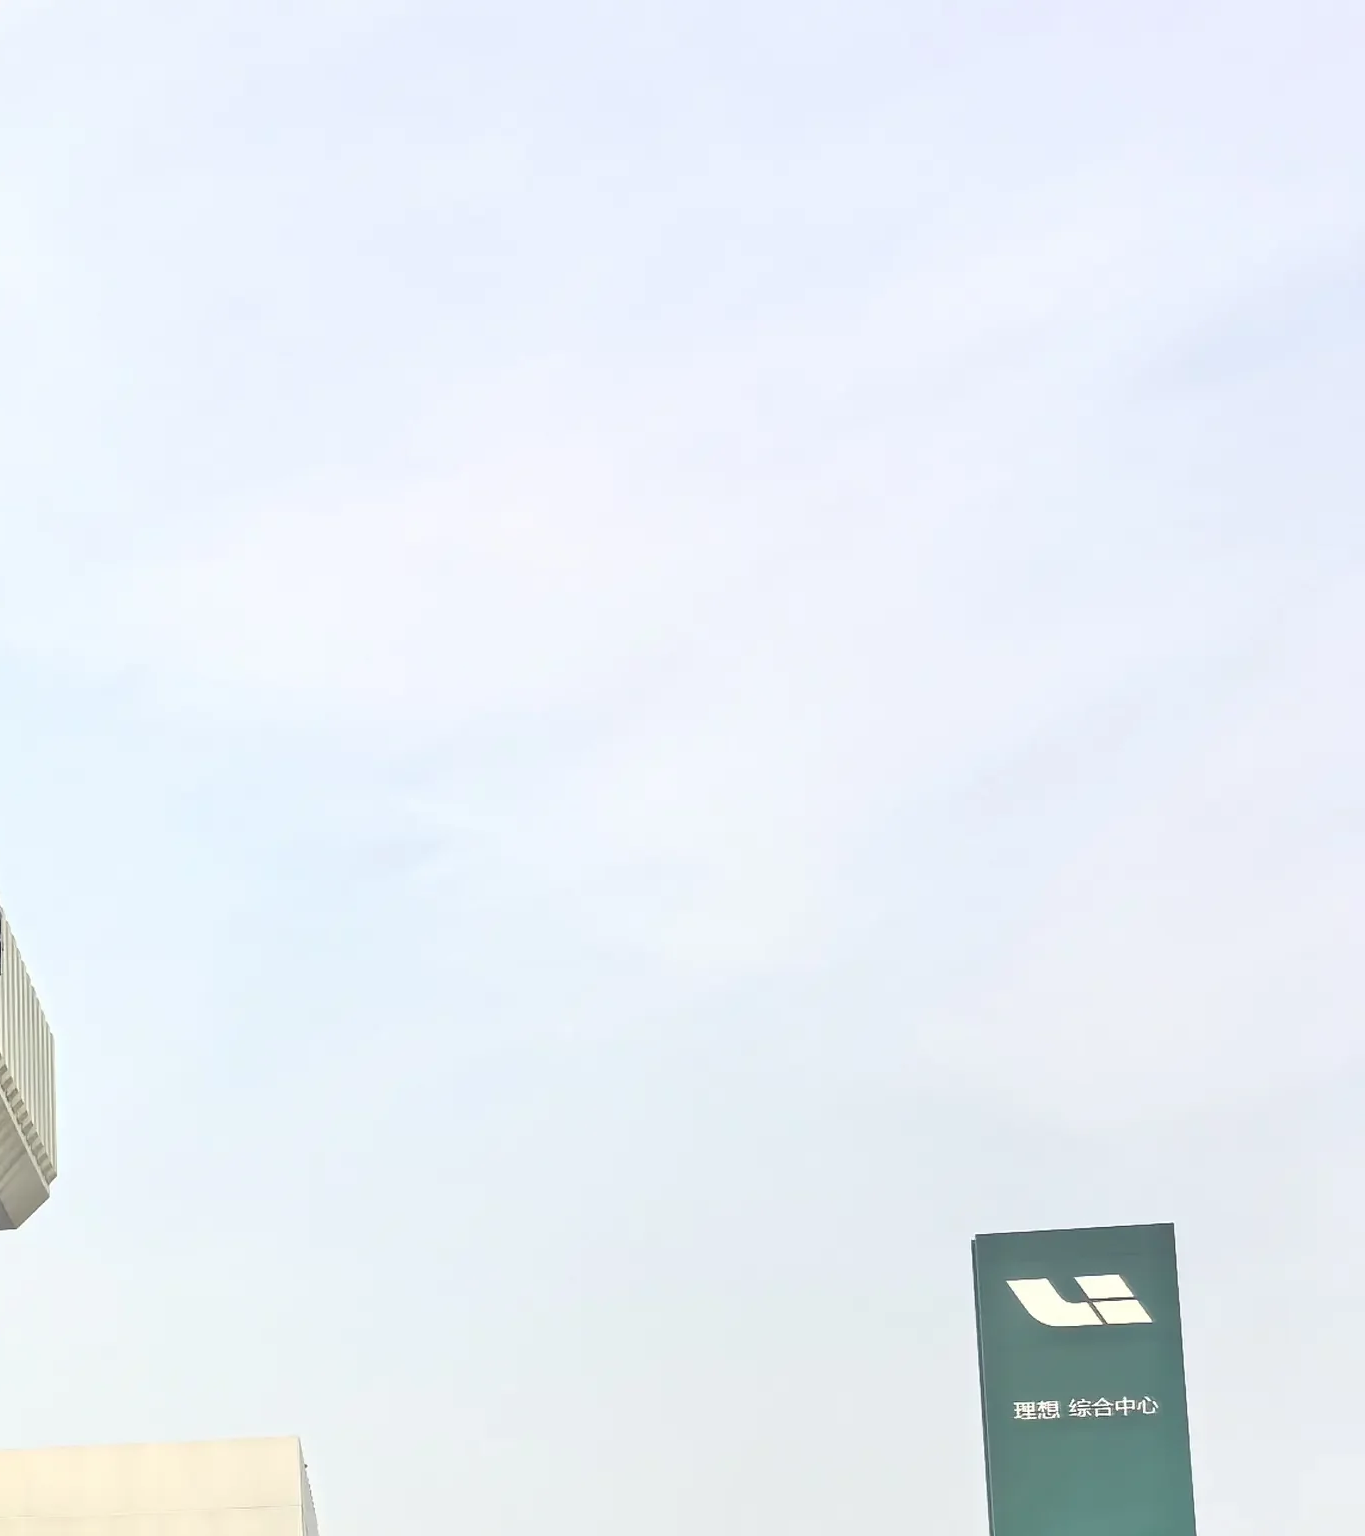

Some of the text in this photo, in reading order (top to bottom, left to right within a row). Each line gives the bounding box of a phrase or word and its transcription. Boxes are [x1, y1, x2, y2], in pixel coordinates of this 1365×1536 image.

[1013, 1395, 1159, 1420] 理想 综合中心
